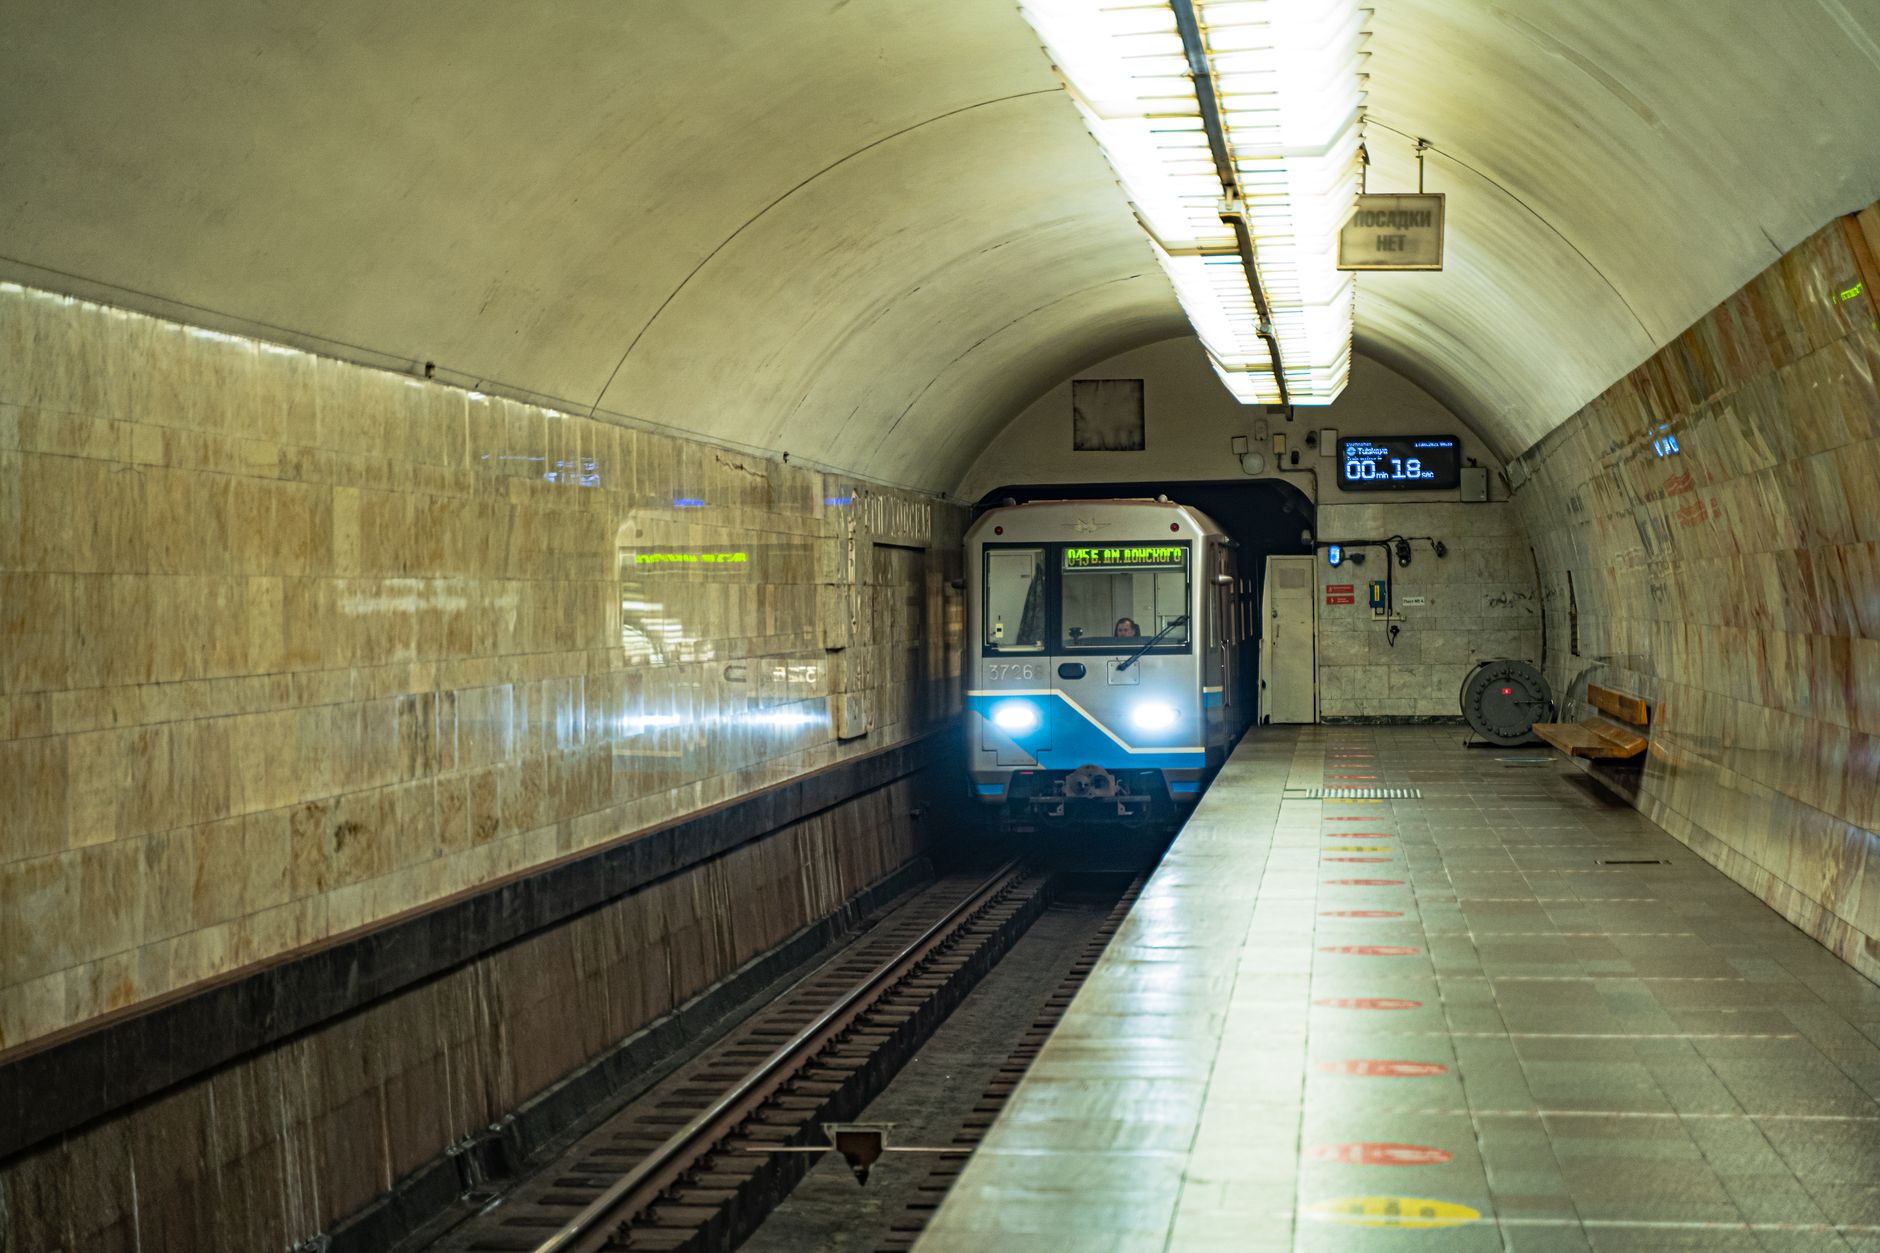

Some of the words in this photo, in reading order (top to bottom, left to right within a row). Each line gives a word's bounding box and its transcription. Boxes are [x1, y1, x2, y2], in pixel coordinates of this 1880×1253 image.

[1353, 209, 1431, 230] ПОСАДКИ
[1376, 234, 1406, 252] НЕТ
[1346, 460, 1376, 479] 00
[1391, 459, 1421, 478] 18
[1123, 547, 1182, 563] ДОНСКОГО
